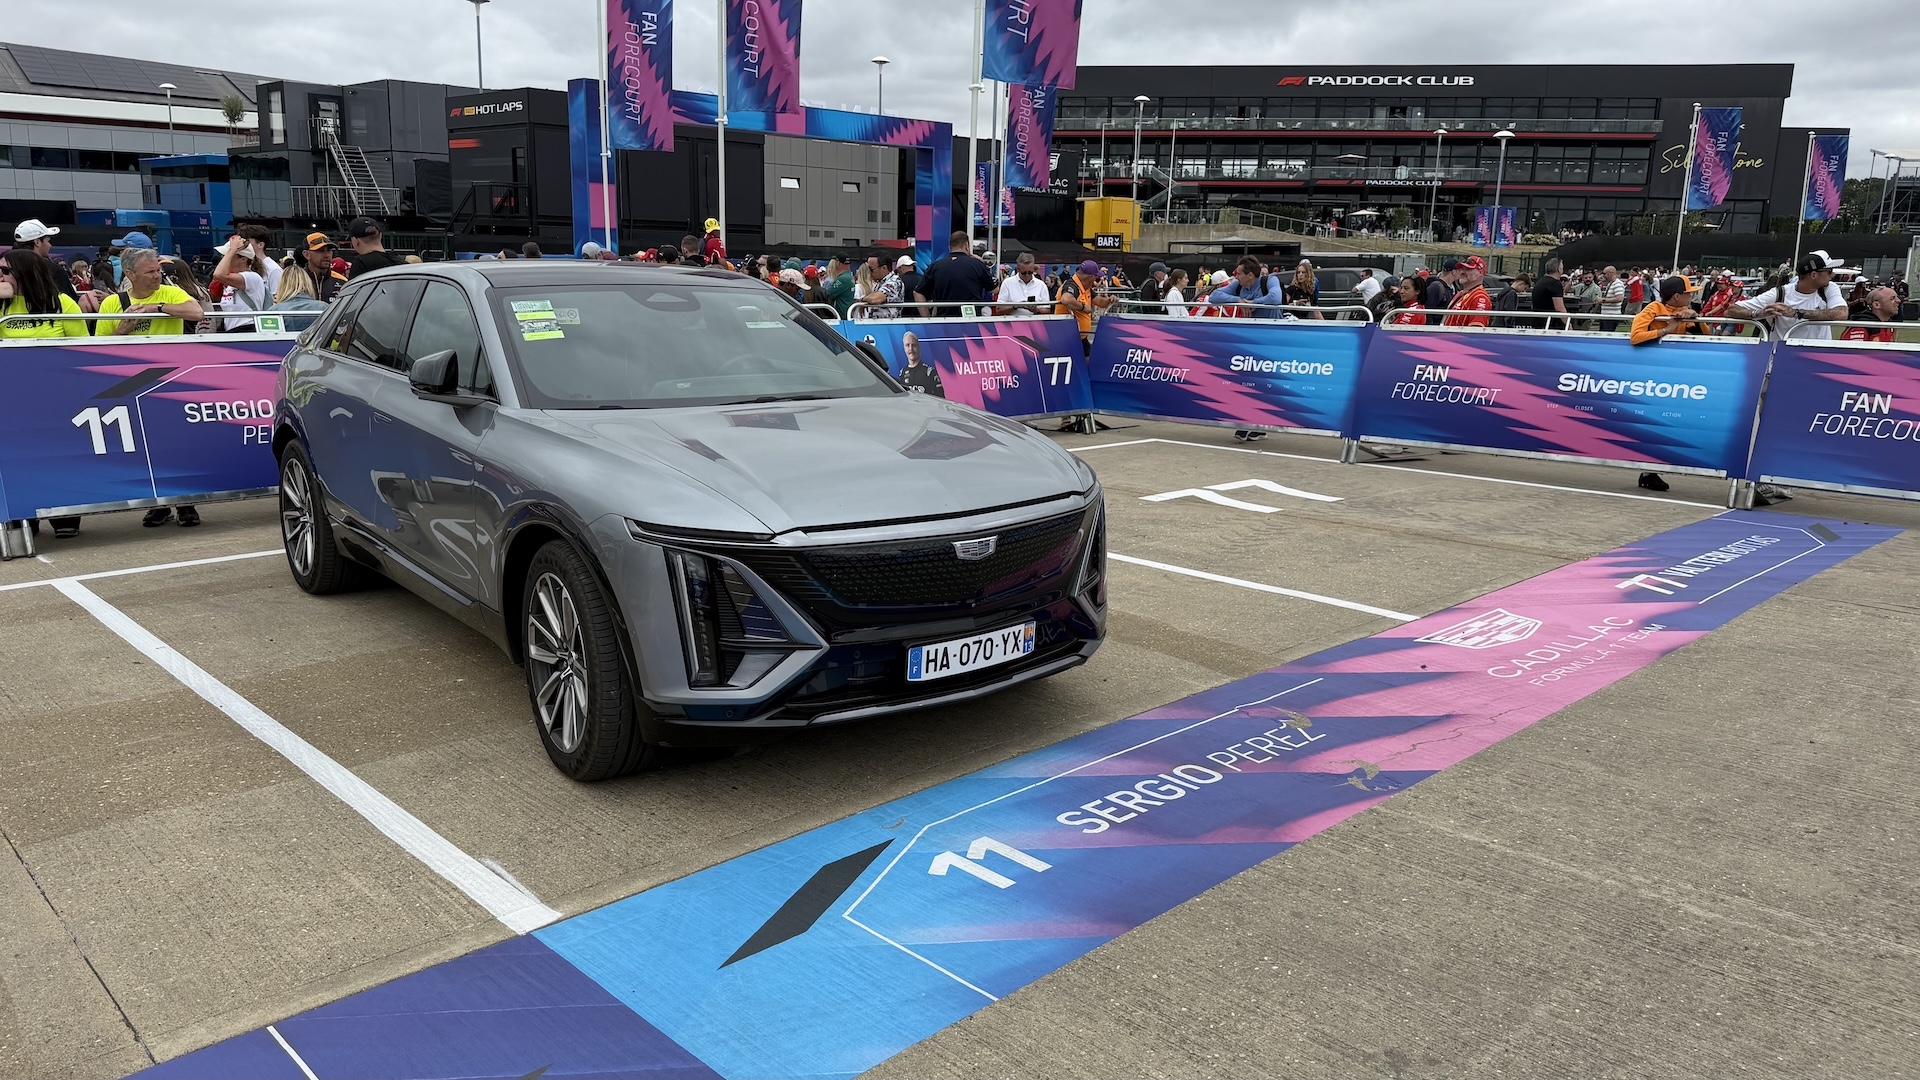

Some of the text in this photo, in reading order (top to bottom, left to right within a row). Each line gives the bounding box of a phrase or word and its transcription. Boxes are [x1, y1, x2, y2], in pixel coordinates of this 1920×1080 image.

[642, 12, 658, 45] FAN
[624, 21, 641, 125] FORECOURT
[1308, 76, 1414, 86] PADDOCK
[1416, 76, 1475, 86] CLUB
[475, 104, 496, 115] HOT
[496, 101, 524, 113] LAPS
[1015, 89, 1033, 169] FORECOURT
[1717, 131, 1729, 152] FAN
[1700, 138, 1717, 195] FORECOURT
[1828, 155, 1839, 172] FAN
[1814, 160, 1828, 208] FORECOURT
[1097, 237, 1114, 247] BAR
[955, 360, 1005, 375] VALTTERI
[1125, 349, 1152, 364] FAN
[1230, 355, 1334, 376] Silverstone
[1043, 356, 1073, 386] 77
[1110, 363, 1190, 383] FORECOURT
[1413, 364, 1450, 382] FAN
[981, 375, 1019, 391] BOTTAS
[1391, 382, 1502, 406] FORECOURT
[1557, 372, 1708, 400] Silverstone
[184, 399, 275, 424] SERGIO
[1841, 391, 1892, 414] FAN
[71, 405, 136, 455] 11
[1615, 573, 1689, 595] 77
[1024, 640, 1033, 652] 13
[1487, 616, 1634, 678] CADILLAC
[1529, 648, 1609, 687] FORMULA
[1618, 623, 1667, 643] TEAM
[1056, 764, 1224, 834] SERGIO
[928, 836, 1053, 889] 11
